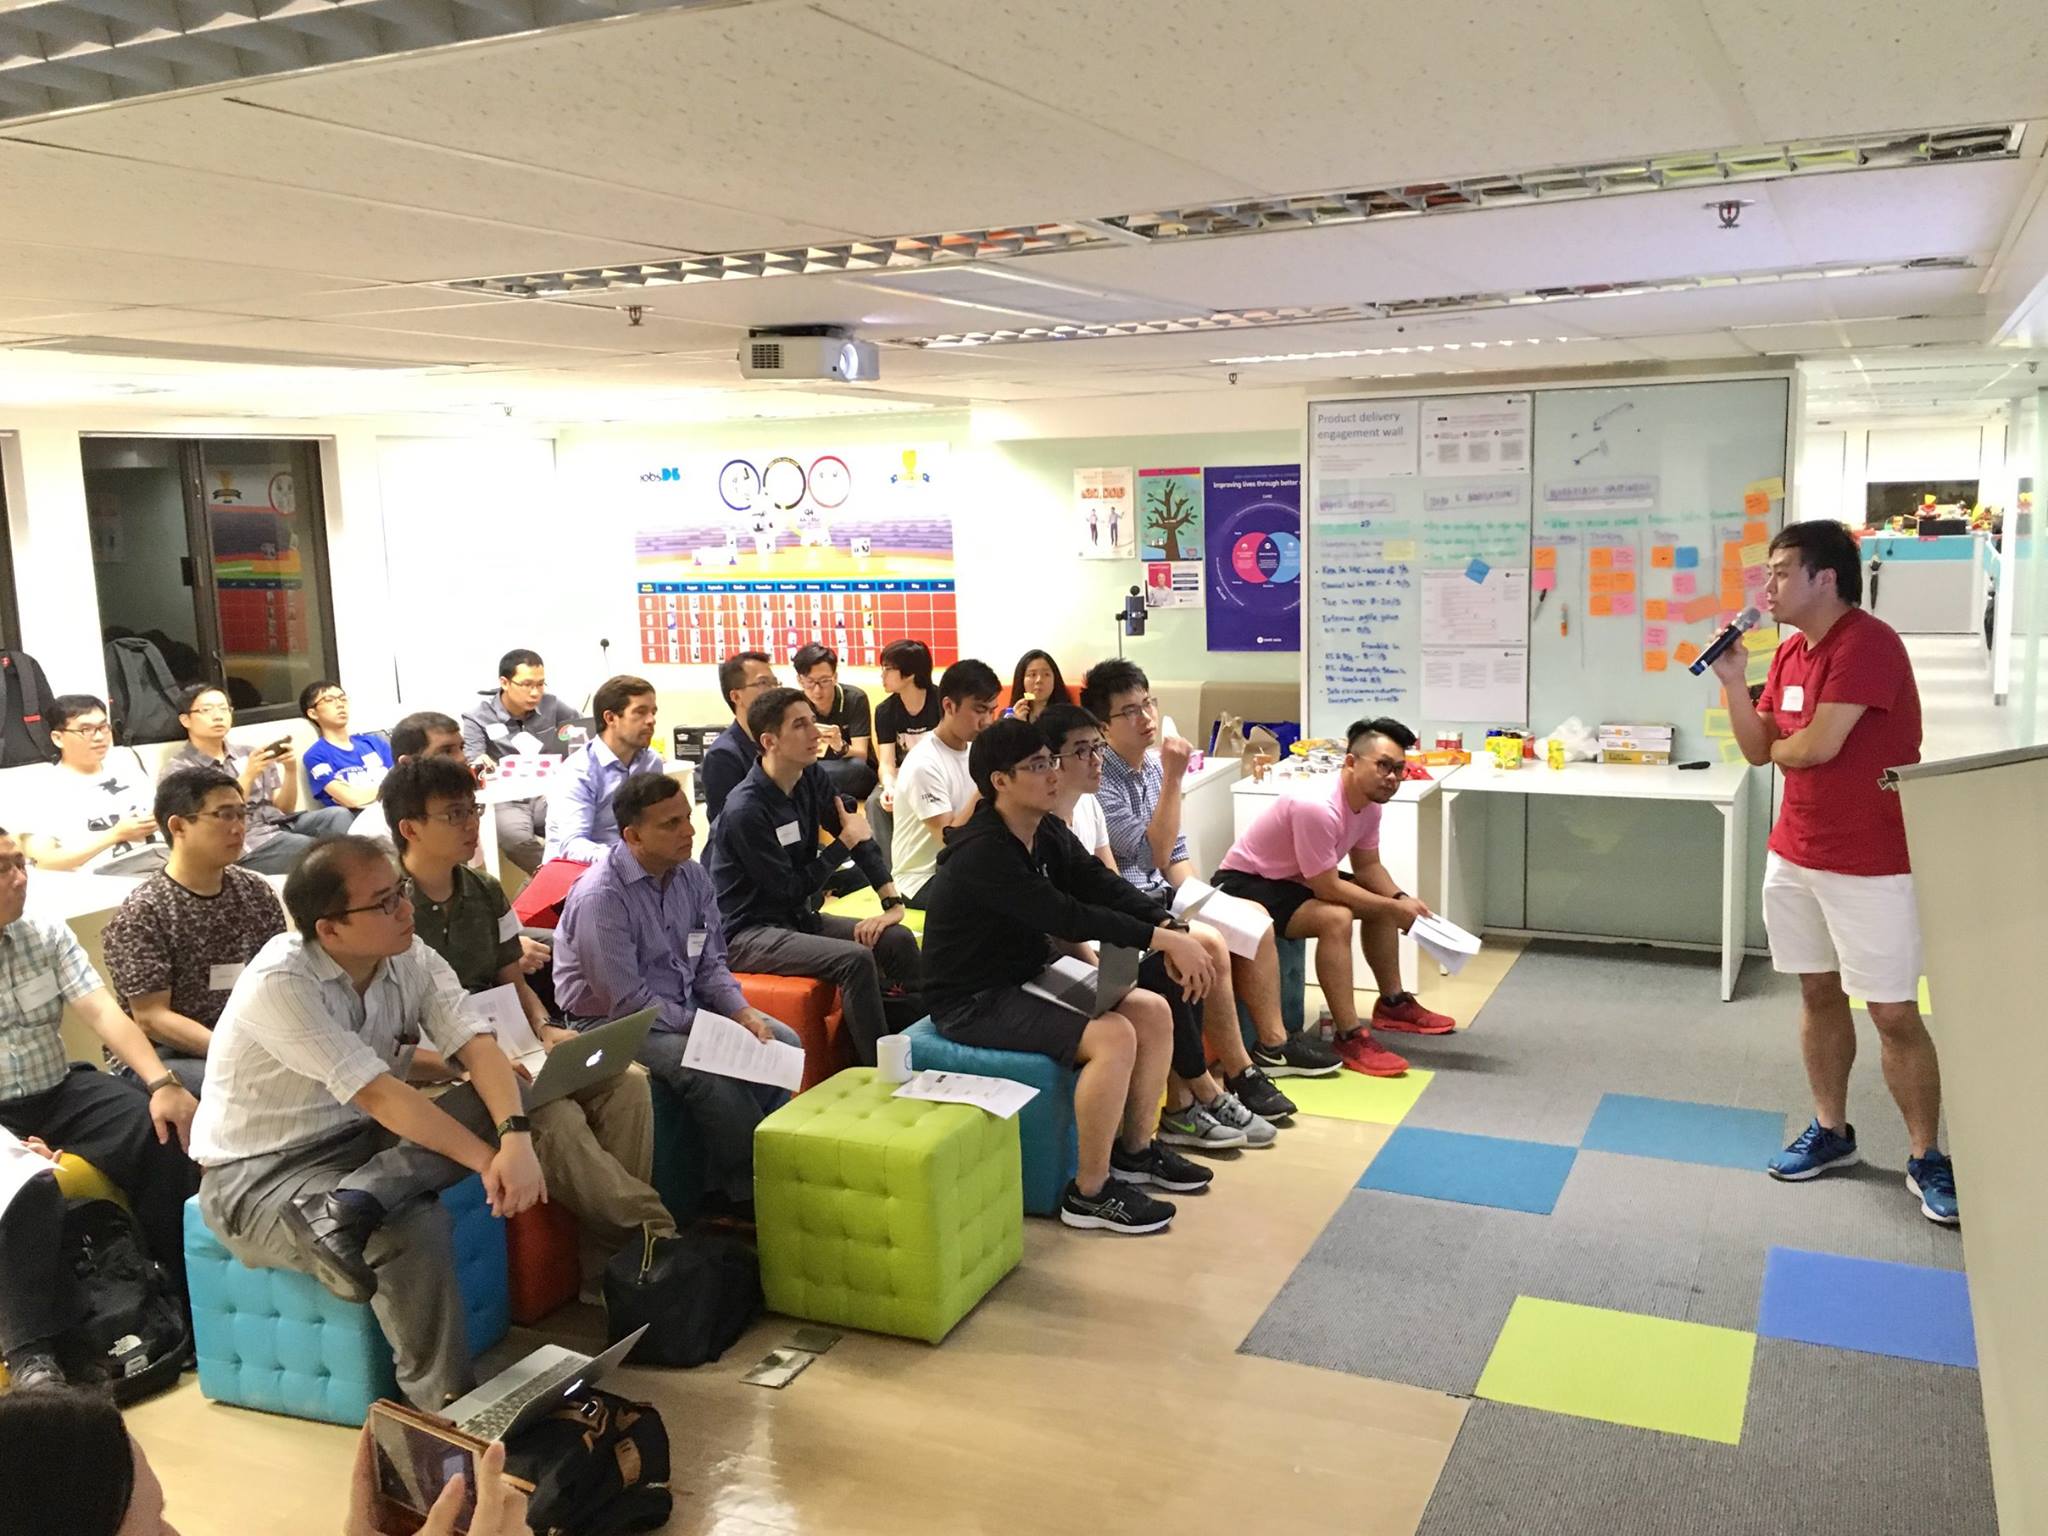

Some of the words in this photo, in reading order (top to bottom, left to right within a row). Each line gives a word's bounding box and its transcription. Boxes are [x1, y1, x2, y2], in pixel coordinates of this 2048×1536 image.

[1318, 414, 1356, 424] Product
[1359, 411, 1401, 422] delivery
[1317, 429, 1380, 441] engagement
[1382, 426, 1404, 437] wall
[1213, 481, 1242, 490] Improving
[1242, 480, 1256, 488] lives
[1257, 479, 1280, 488] through
[1280, 479, 1298, 487] better
